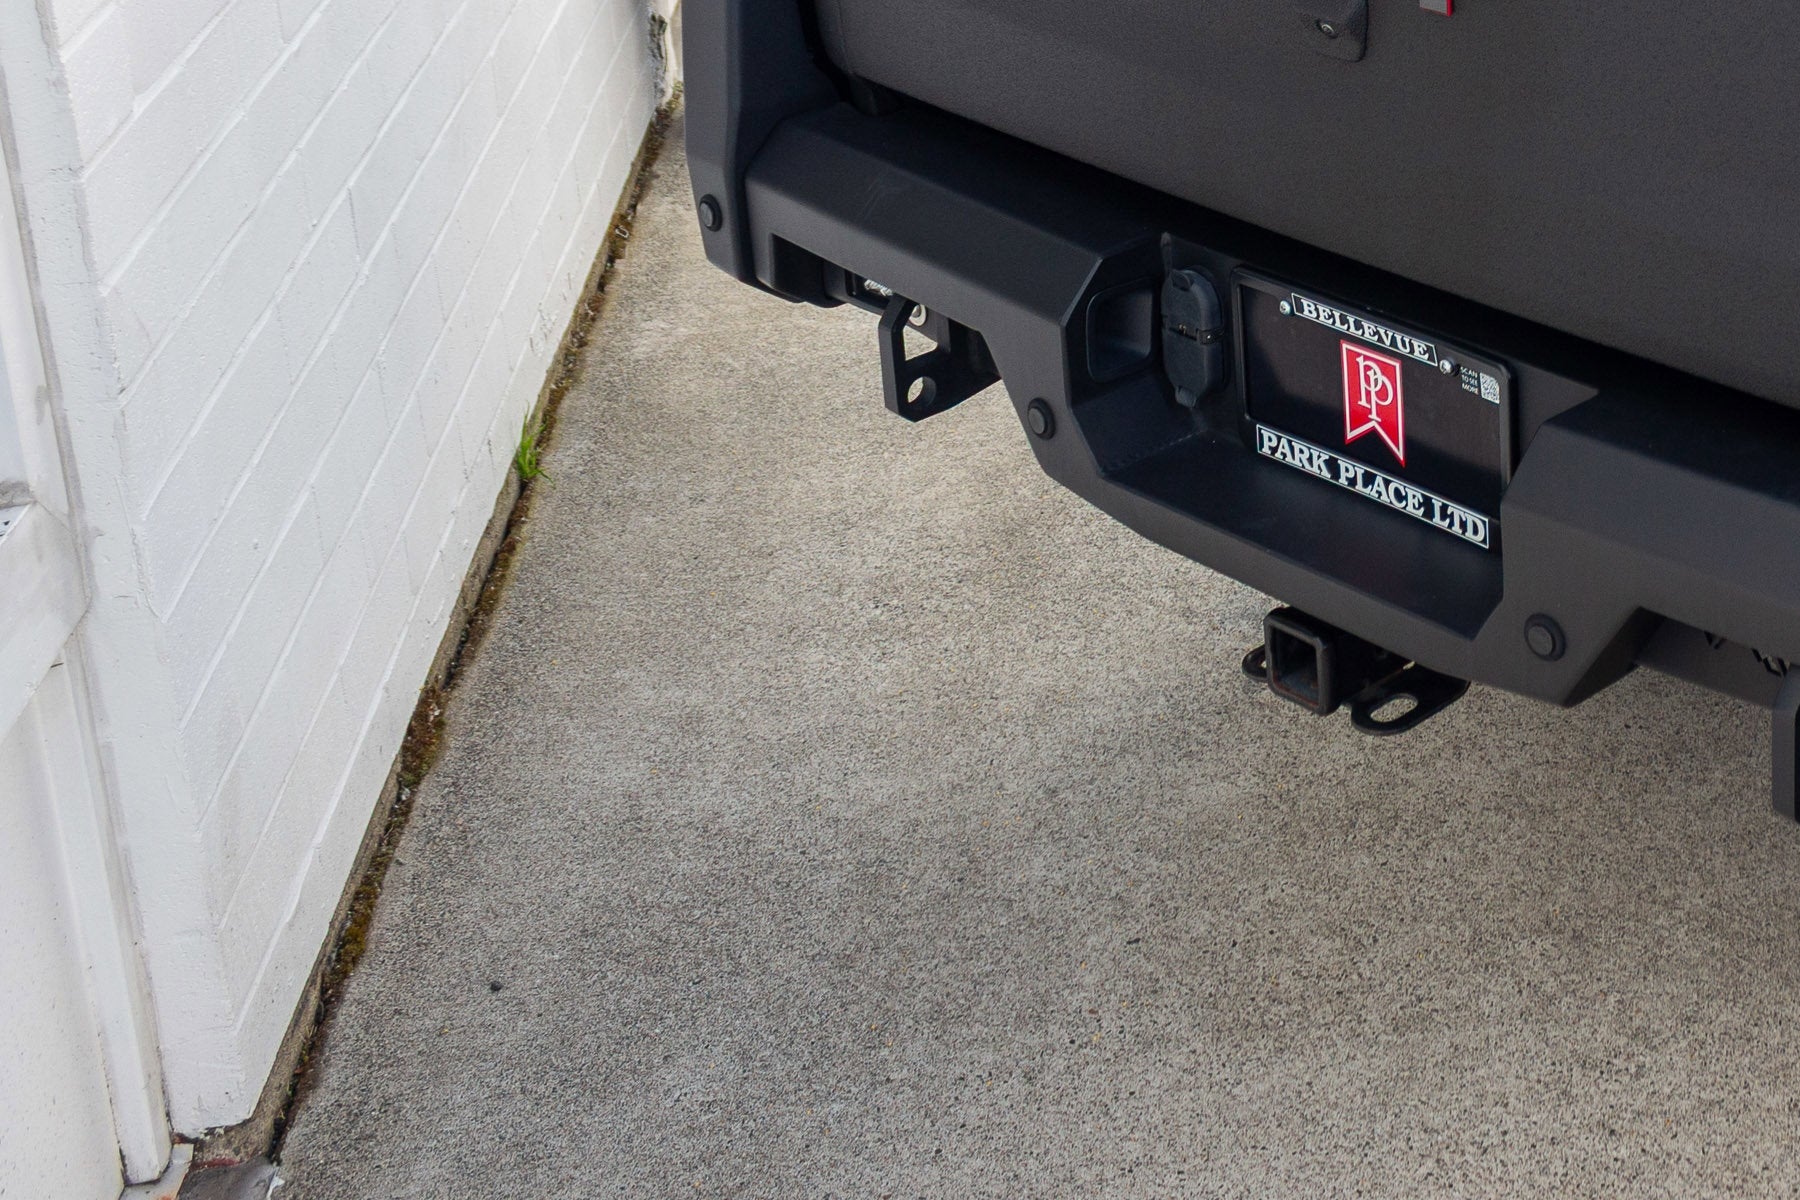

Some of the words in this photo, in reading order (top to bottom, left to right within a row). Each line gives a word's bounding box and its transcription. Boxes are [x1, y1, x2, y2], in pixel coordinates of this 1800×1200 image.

[1301, 298, 1430, 361] BELLEVUE
[1460, 366, 1478, 378] SCAN
[1461, 383, 1479, 395] MORE
[1261, 429, 1332, 479] PARK
[1338, 459, 1425, 517] PLACE
[1432, 499, 1486, 543] LTD
